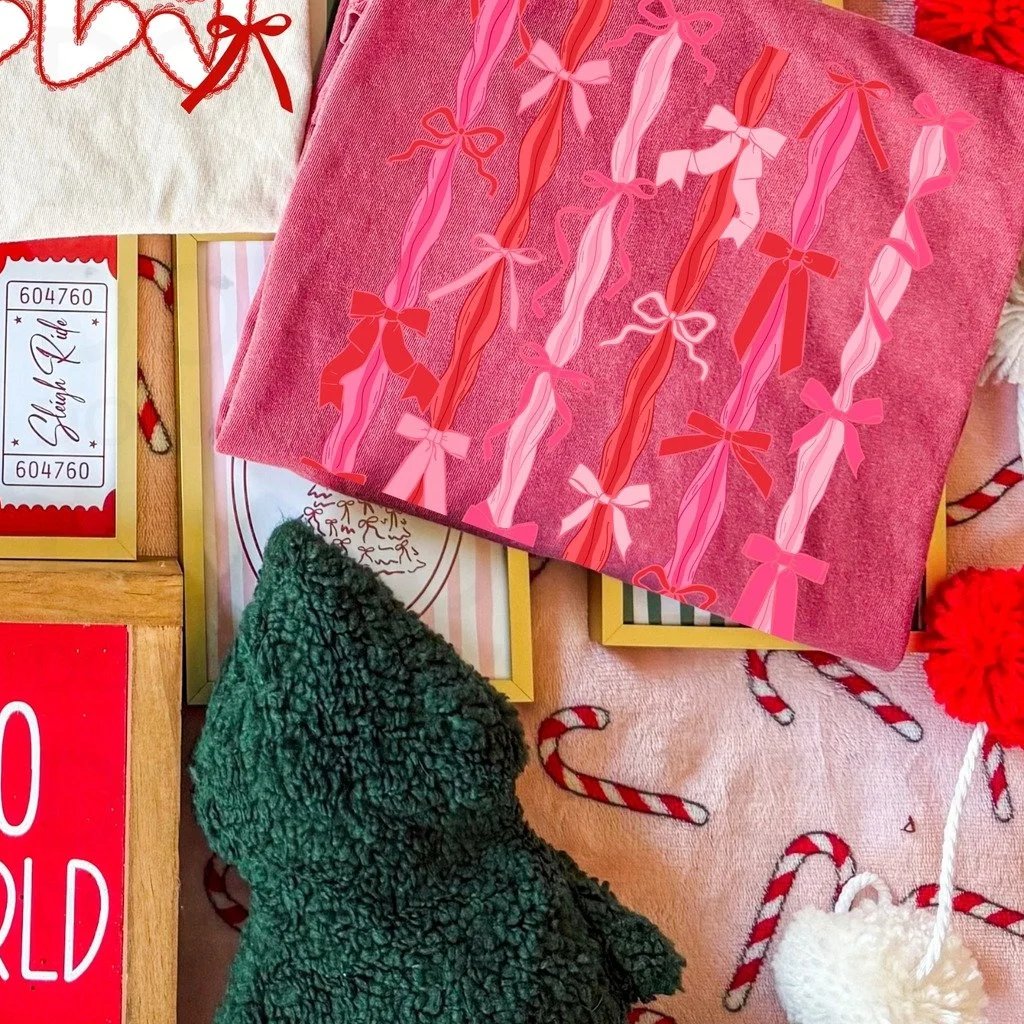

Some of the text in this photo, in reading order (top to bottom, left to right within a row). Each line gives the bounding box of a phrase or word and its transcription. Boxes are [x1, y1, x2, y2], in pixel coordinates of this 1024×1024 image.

[19, 286, 93, 306] 604760
[27, 317, 86, 447] Sleigh Ride
[15, 460, 90, 480] 604760
